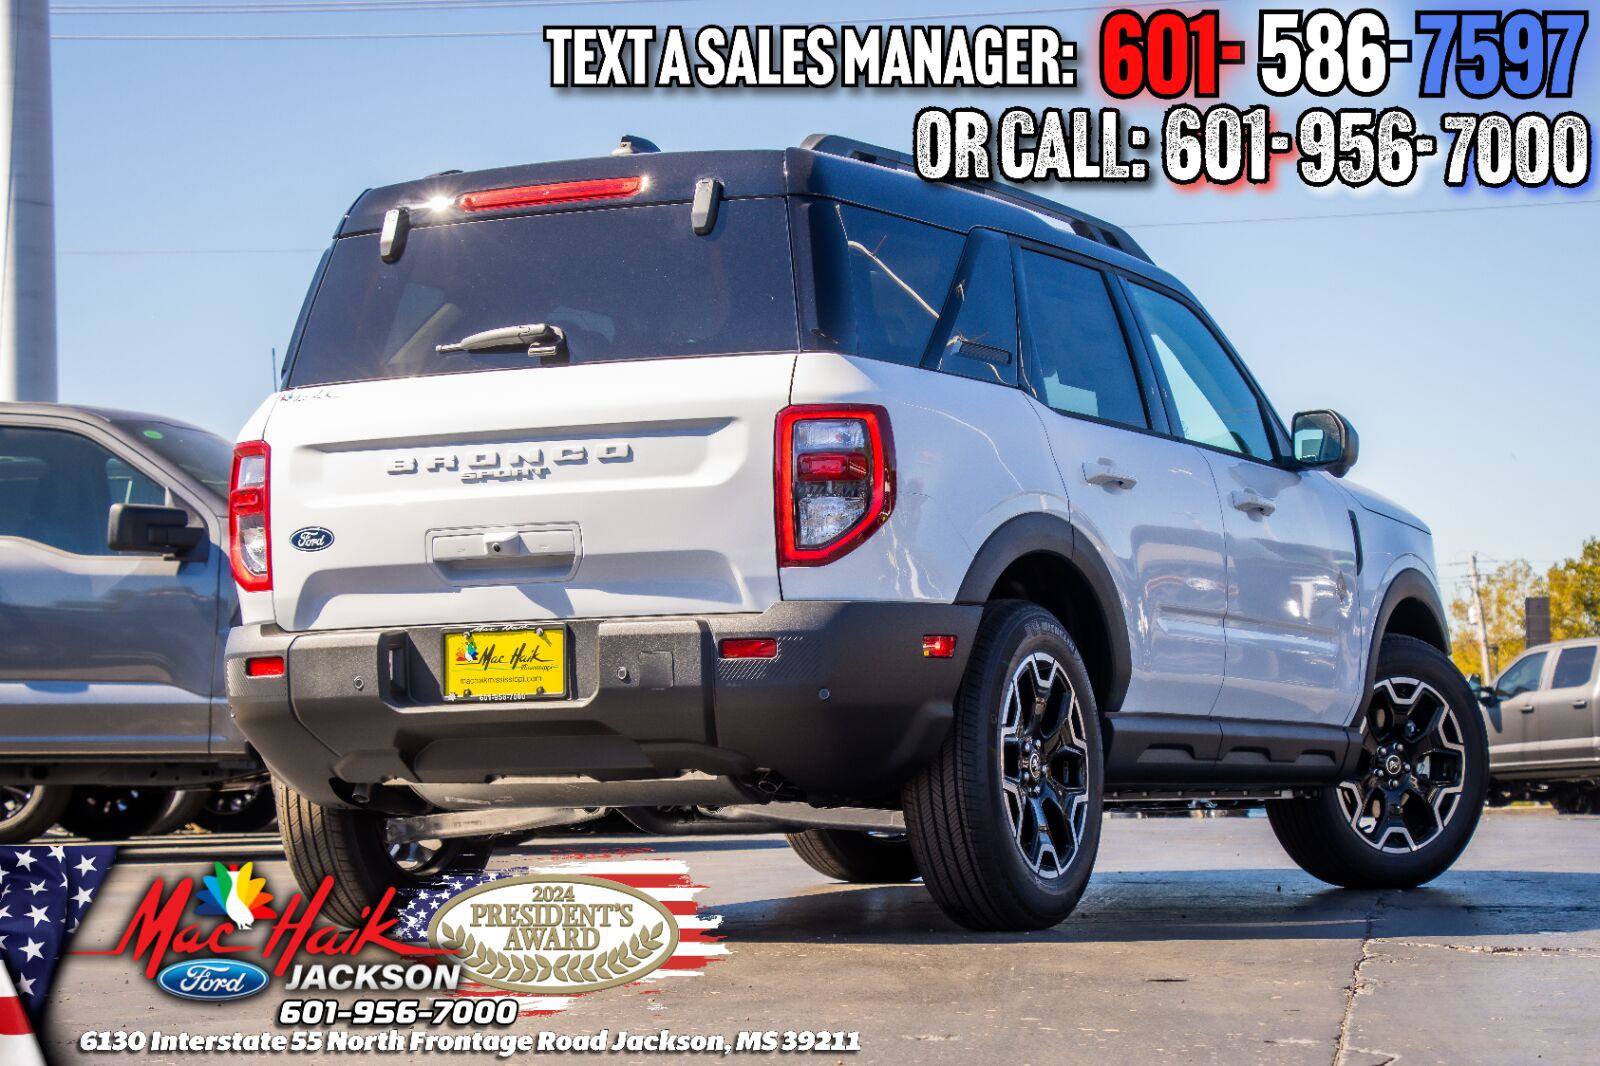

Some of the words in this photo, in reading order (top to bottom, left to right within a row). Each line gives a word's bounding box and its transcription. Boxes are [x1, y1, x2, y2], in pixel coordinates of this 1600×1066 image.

[387, 443, 634, 475] BRONCO
[461, 467, 551, 484] SPORT
[297, 531, 326, 547] Ford
[479, 643, 506, 671] Mac
[510, 642, 545, 670] Haik
